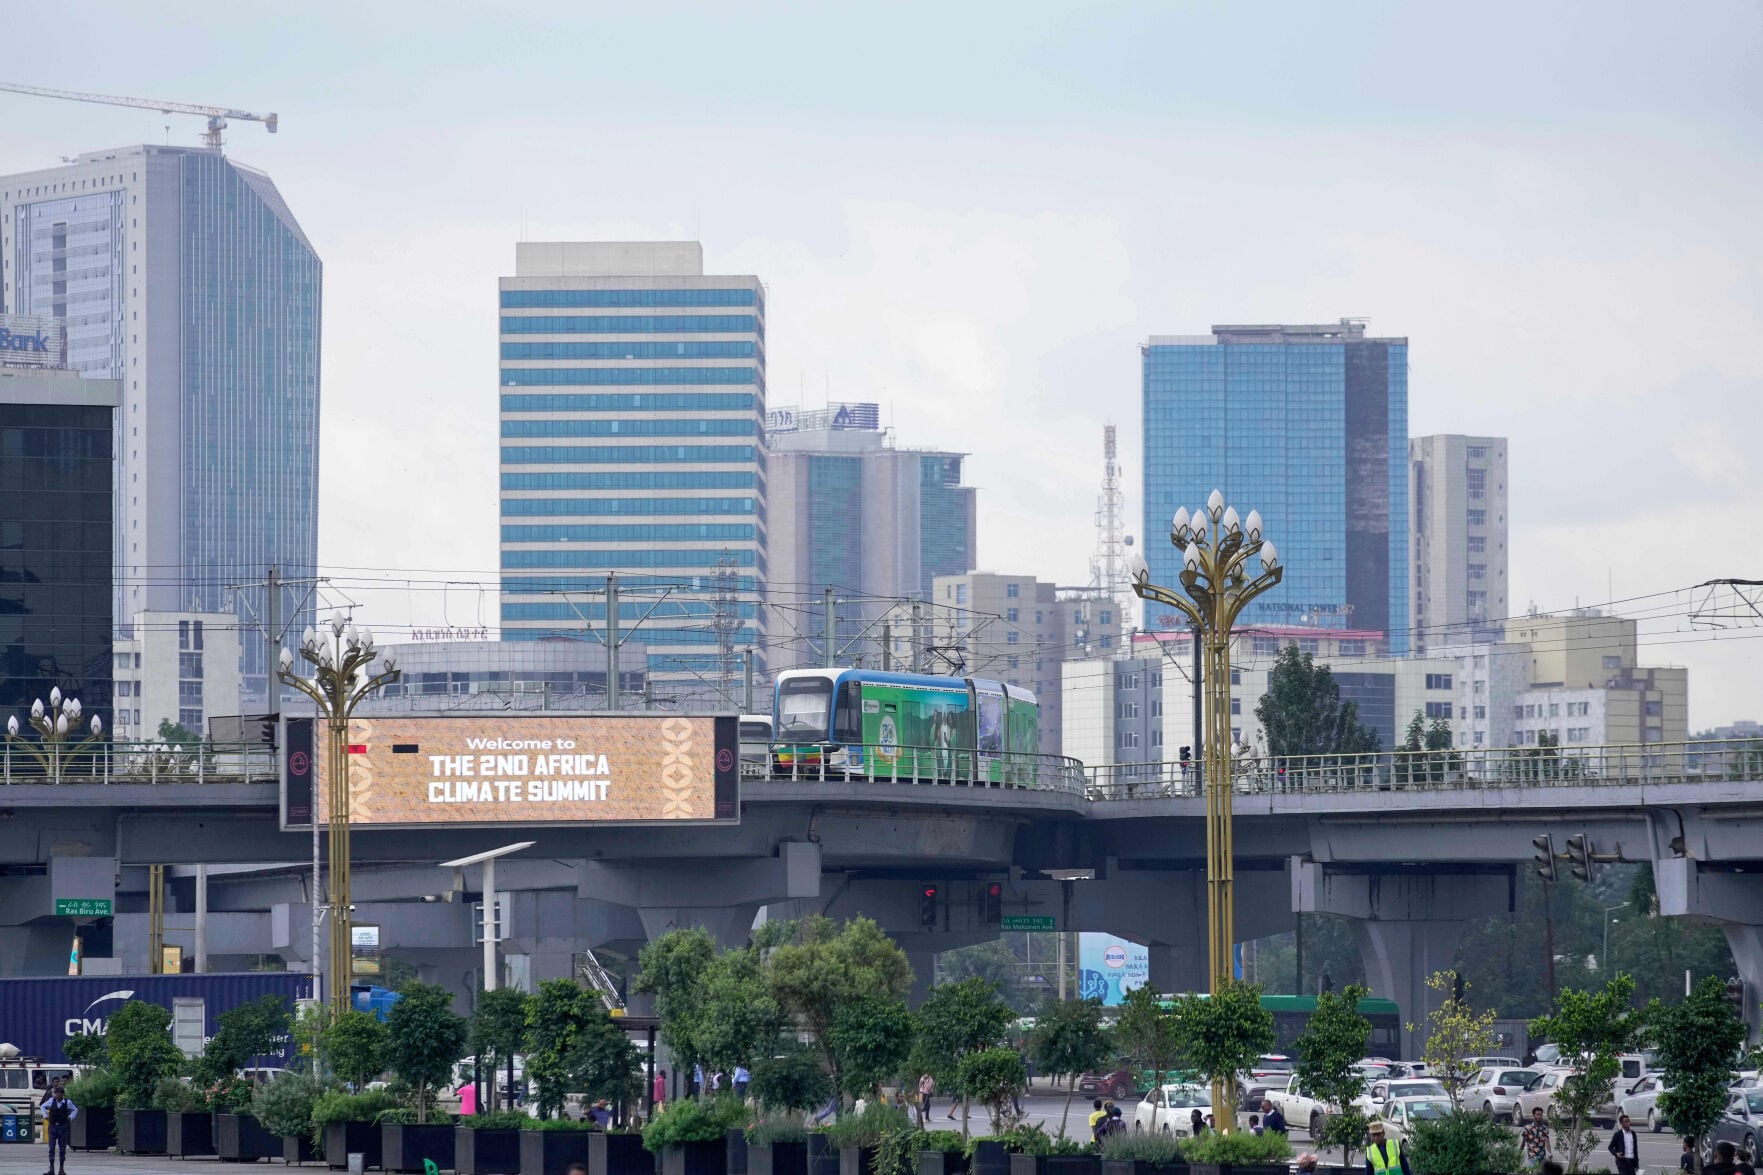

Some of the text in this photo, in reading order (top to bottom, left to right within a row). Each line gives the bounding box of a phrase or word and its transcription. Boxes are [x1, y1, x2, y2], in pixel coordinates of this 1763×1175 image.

[0, 327, 50, 352] Bank
[1258, 602, 1338, 613] NATIONAL TOWER
[466, 737, 576, 750] Welcome to
[428, 754, 610, 777] THE 2ND AFRICA
[428, 780, 612, 803] CLIMATE SUMMIT
[65, 907, 110, 915] Ras Biru Ave.
